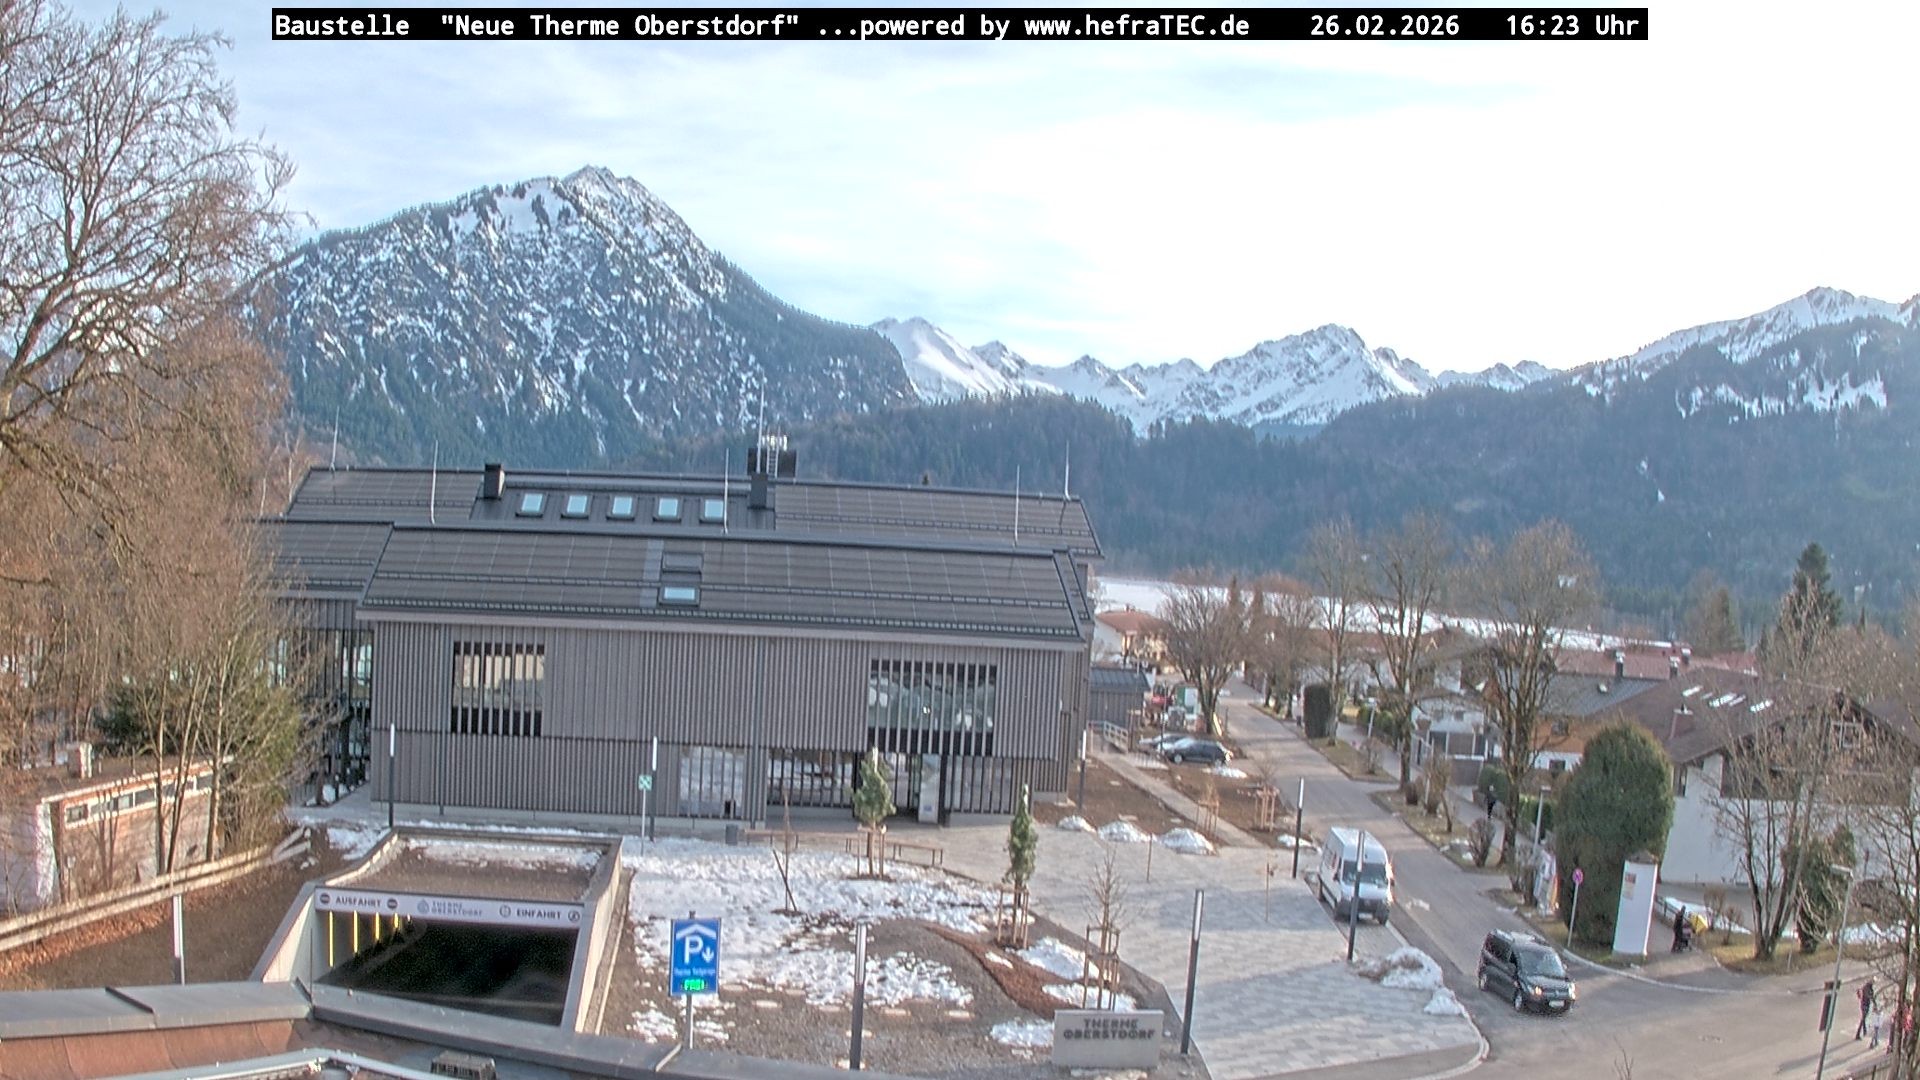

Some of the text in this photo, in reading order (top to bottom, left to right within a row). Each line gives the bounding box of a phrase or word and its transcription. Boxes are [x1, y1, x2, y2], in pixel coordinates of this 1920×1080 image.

[684, 935, 704, 964] P
[1083, 1019, 1139, 1029] THERME
[1063, 1029, 1156, 1039] OBERSTDORF
